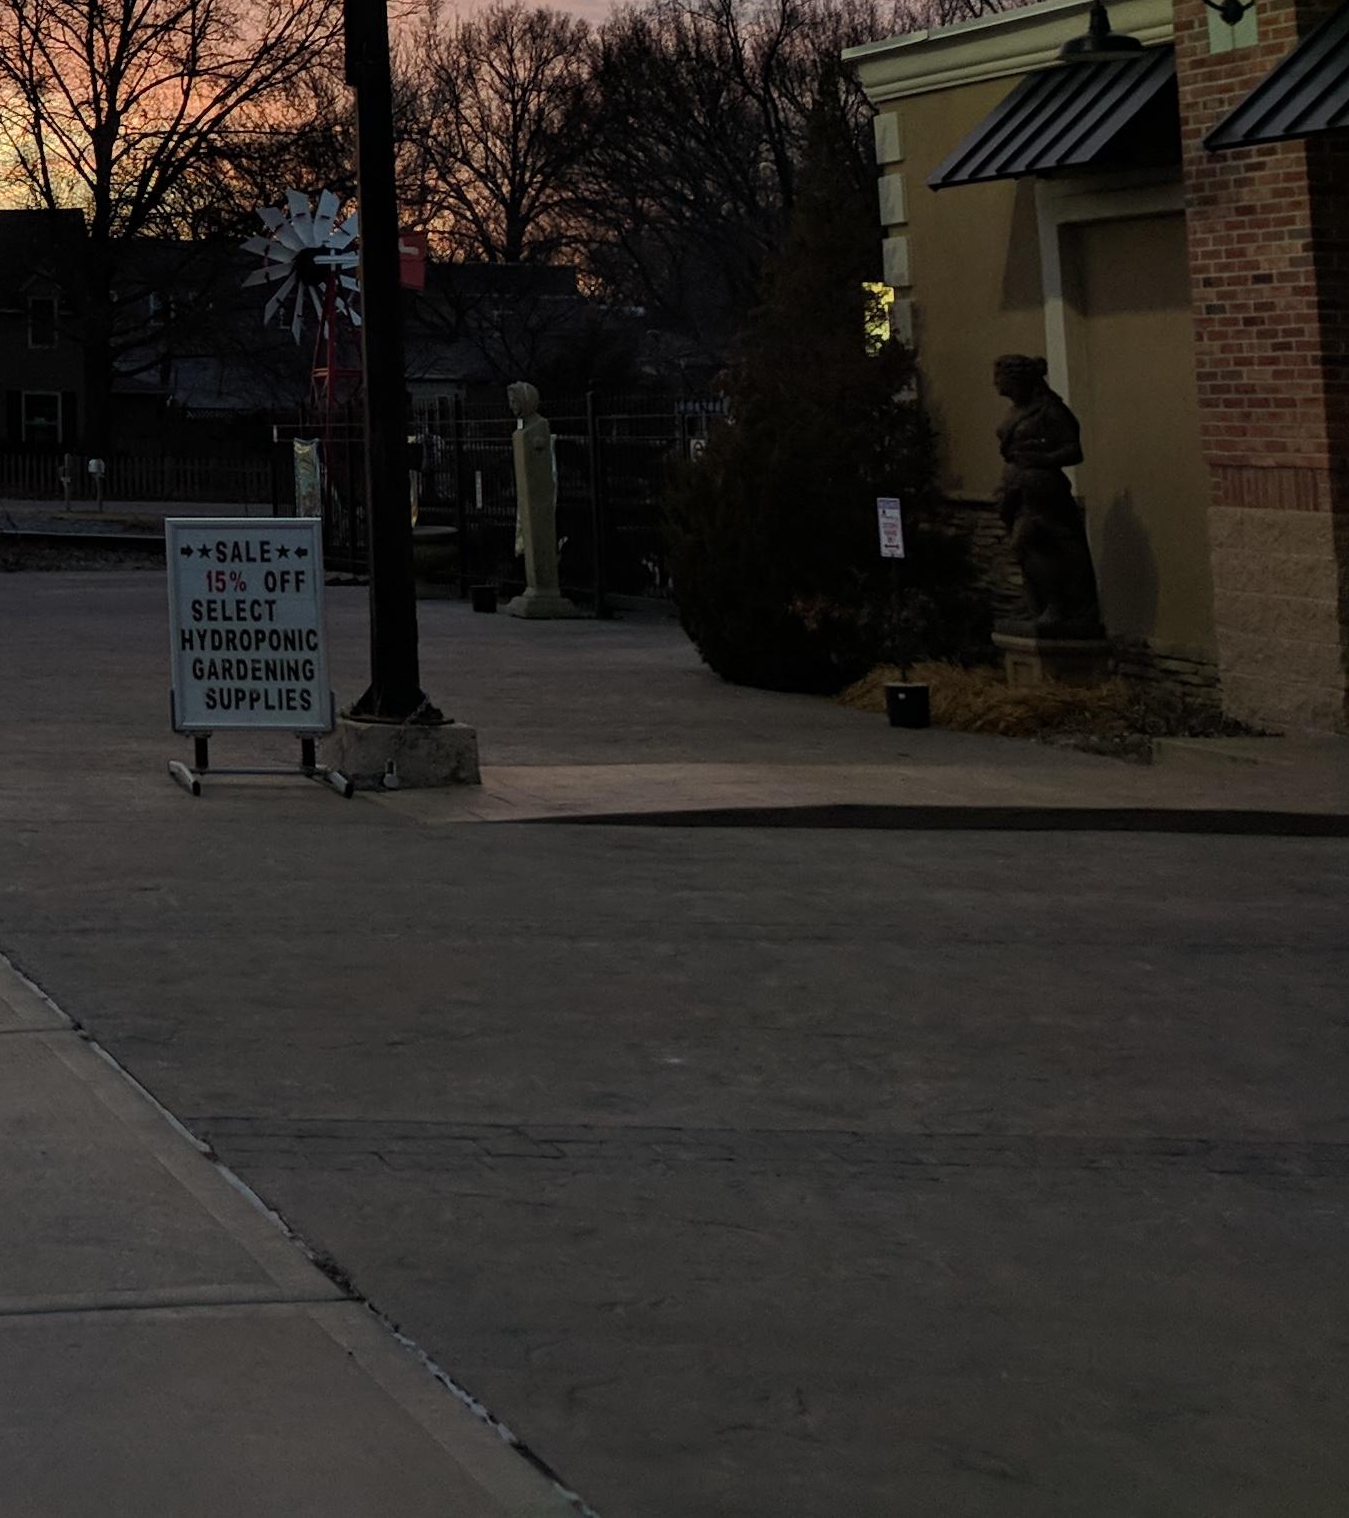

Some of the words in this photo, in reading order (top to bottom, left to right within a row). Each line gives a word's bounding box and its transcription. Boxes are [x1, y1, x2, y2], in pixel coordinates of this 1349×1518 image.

[215, 541, 272, 562] SALE
[206, 570, 246, 593] 15%
[264, 570, 306, 593] OFF
[191, 599, 276, 622] SELECT
[181, 629, 318, 651] HYDROPONIC
[192, 658, 315, 681] GARDENING
[205, 688, 312, 711] SUPPLIES
